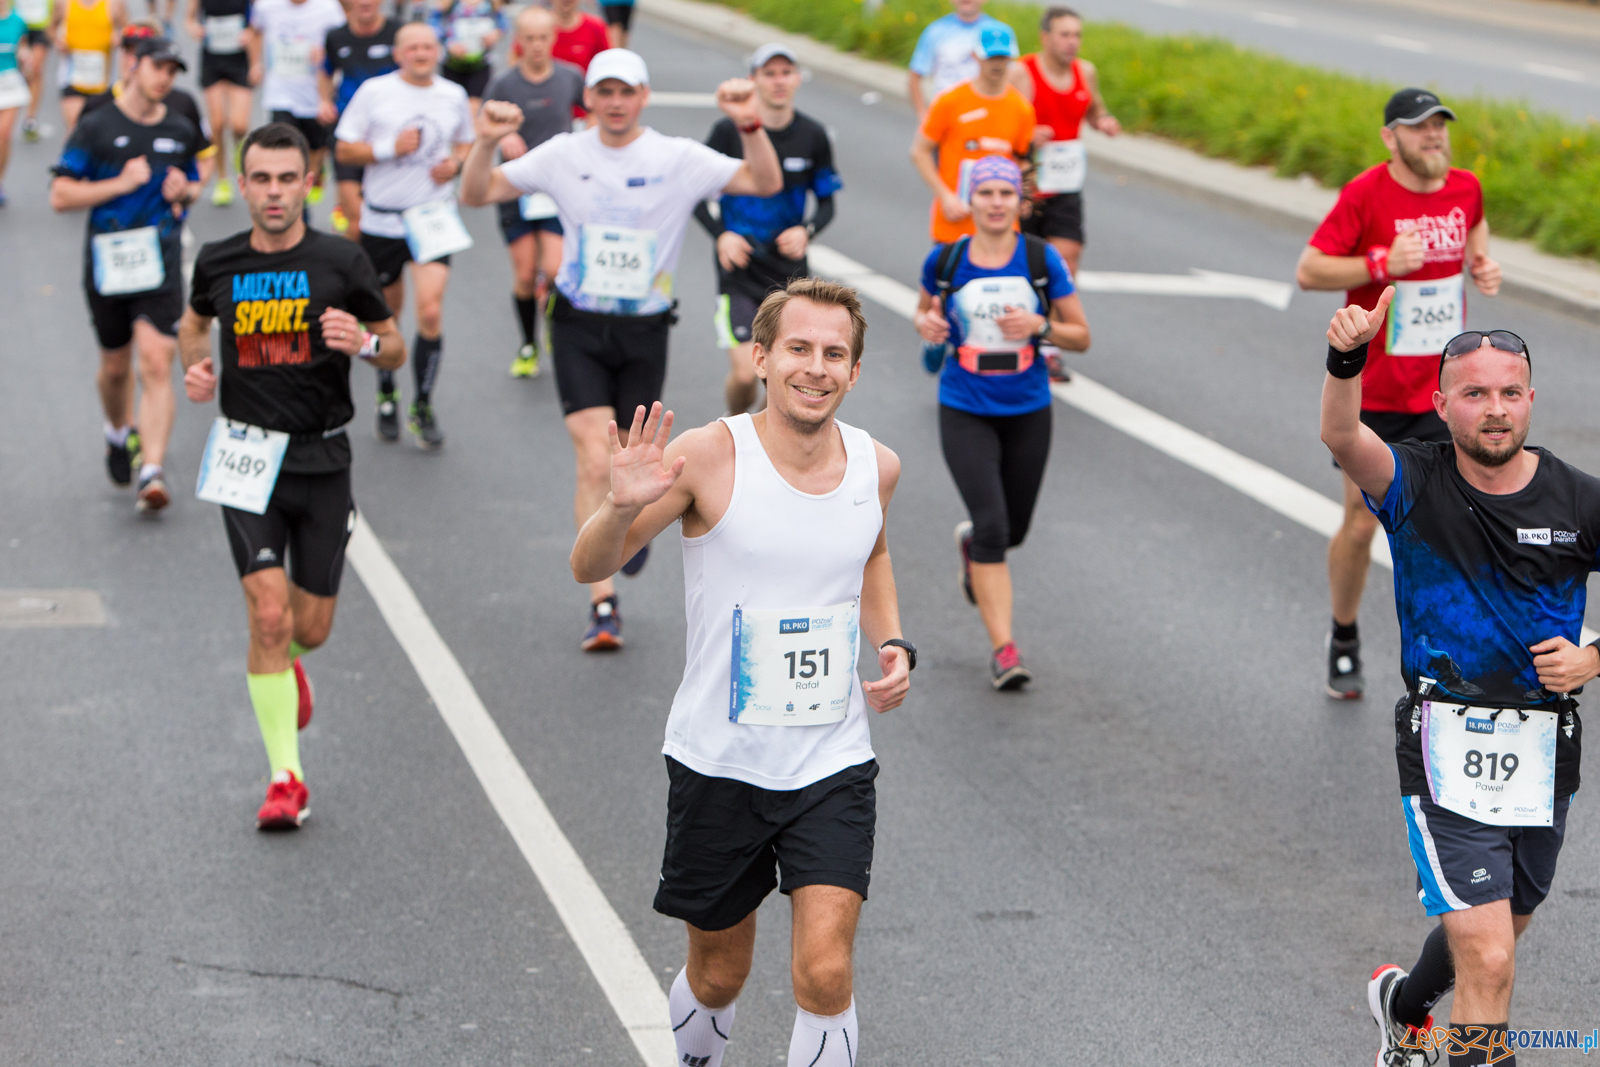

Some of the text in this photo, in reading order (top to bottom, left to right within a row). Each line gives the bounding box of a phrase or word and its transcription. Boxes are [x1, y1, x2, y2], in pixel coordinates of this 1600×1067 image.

[596, 250, 642, 269] 4136
[232, 271, 311, 302] MUZYKA
[233, 298, 310, 335] SPORT.
[1411, 303, 1455, 325] 2662
[216, 448, 266, 478] 7489
[1520, 532, 1549, 540] 18. PKO
[793, 621, 807, 630] PKO
[784, 648, 829, 679] 151
[795, 680, 820, 690] Rafał
[809, 703, 820, 711] 4F
[1468, 721, 1493, 731] 18. PKO
[1463, 749, 1519, 782] 819
[1475, 781, 1504, 792] Paweł
